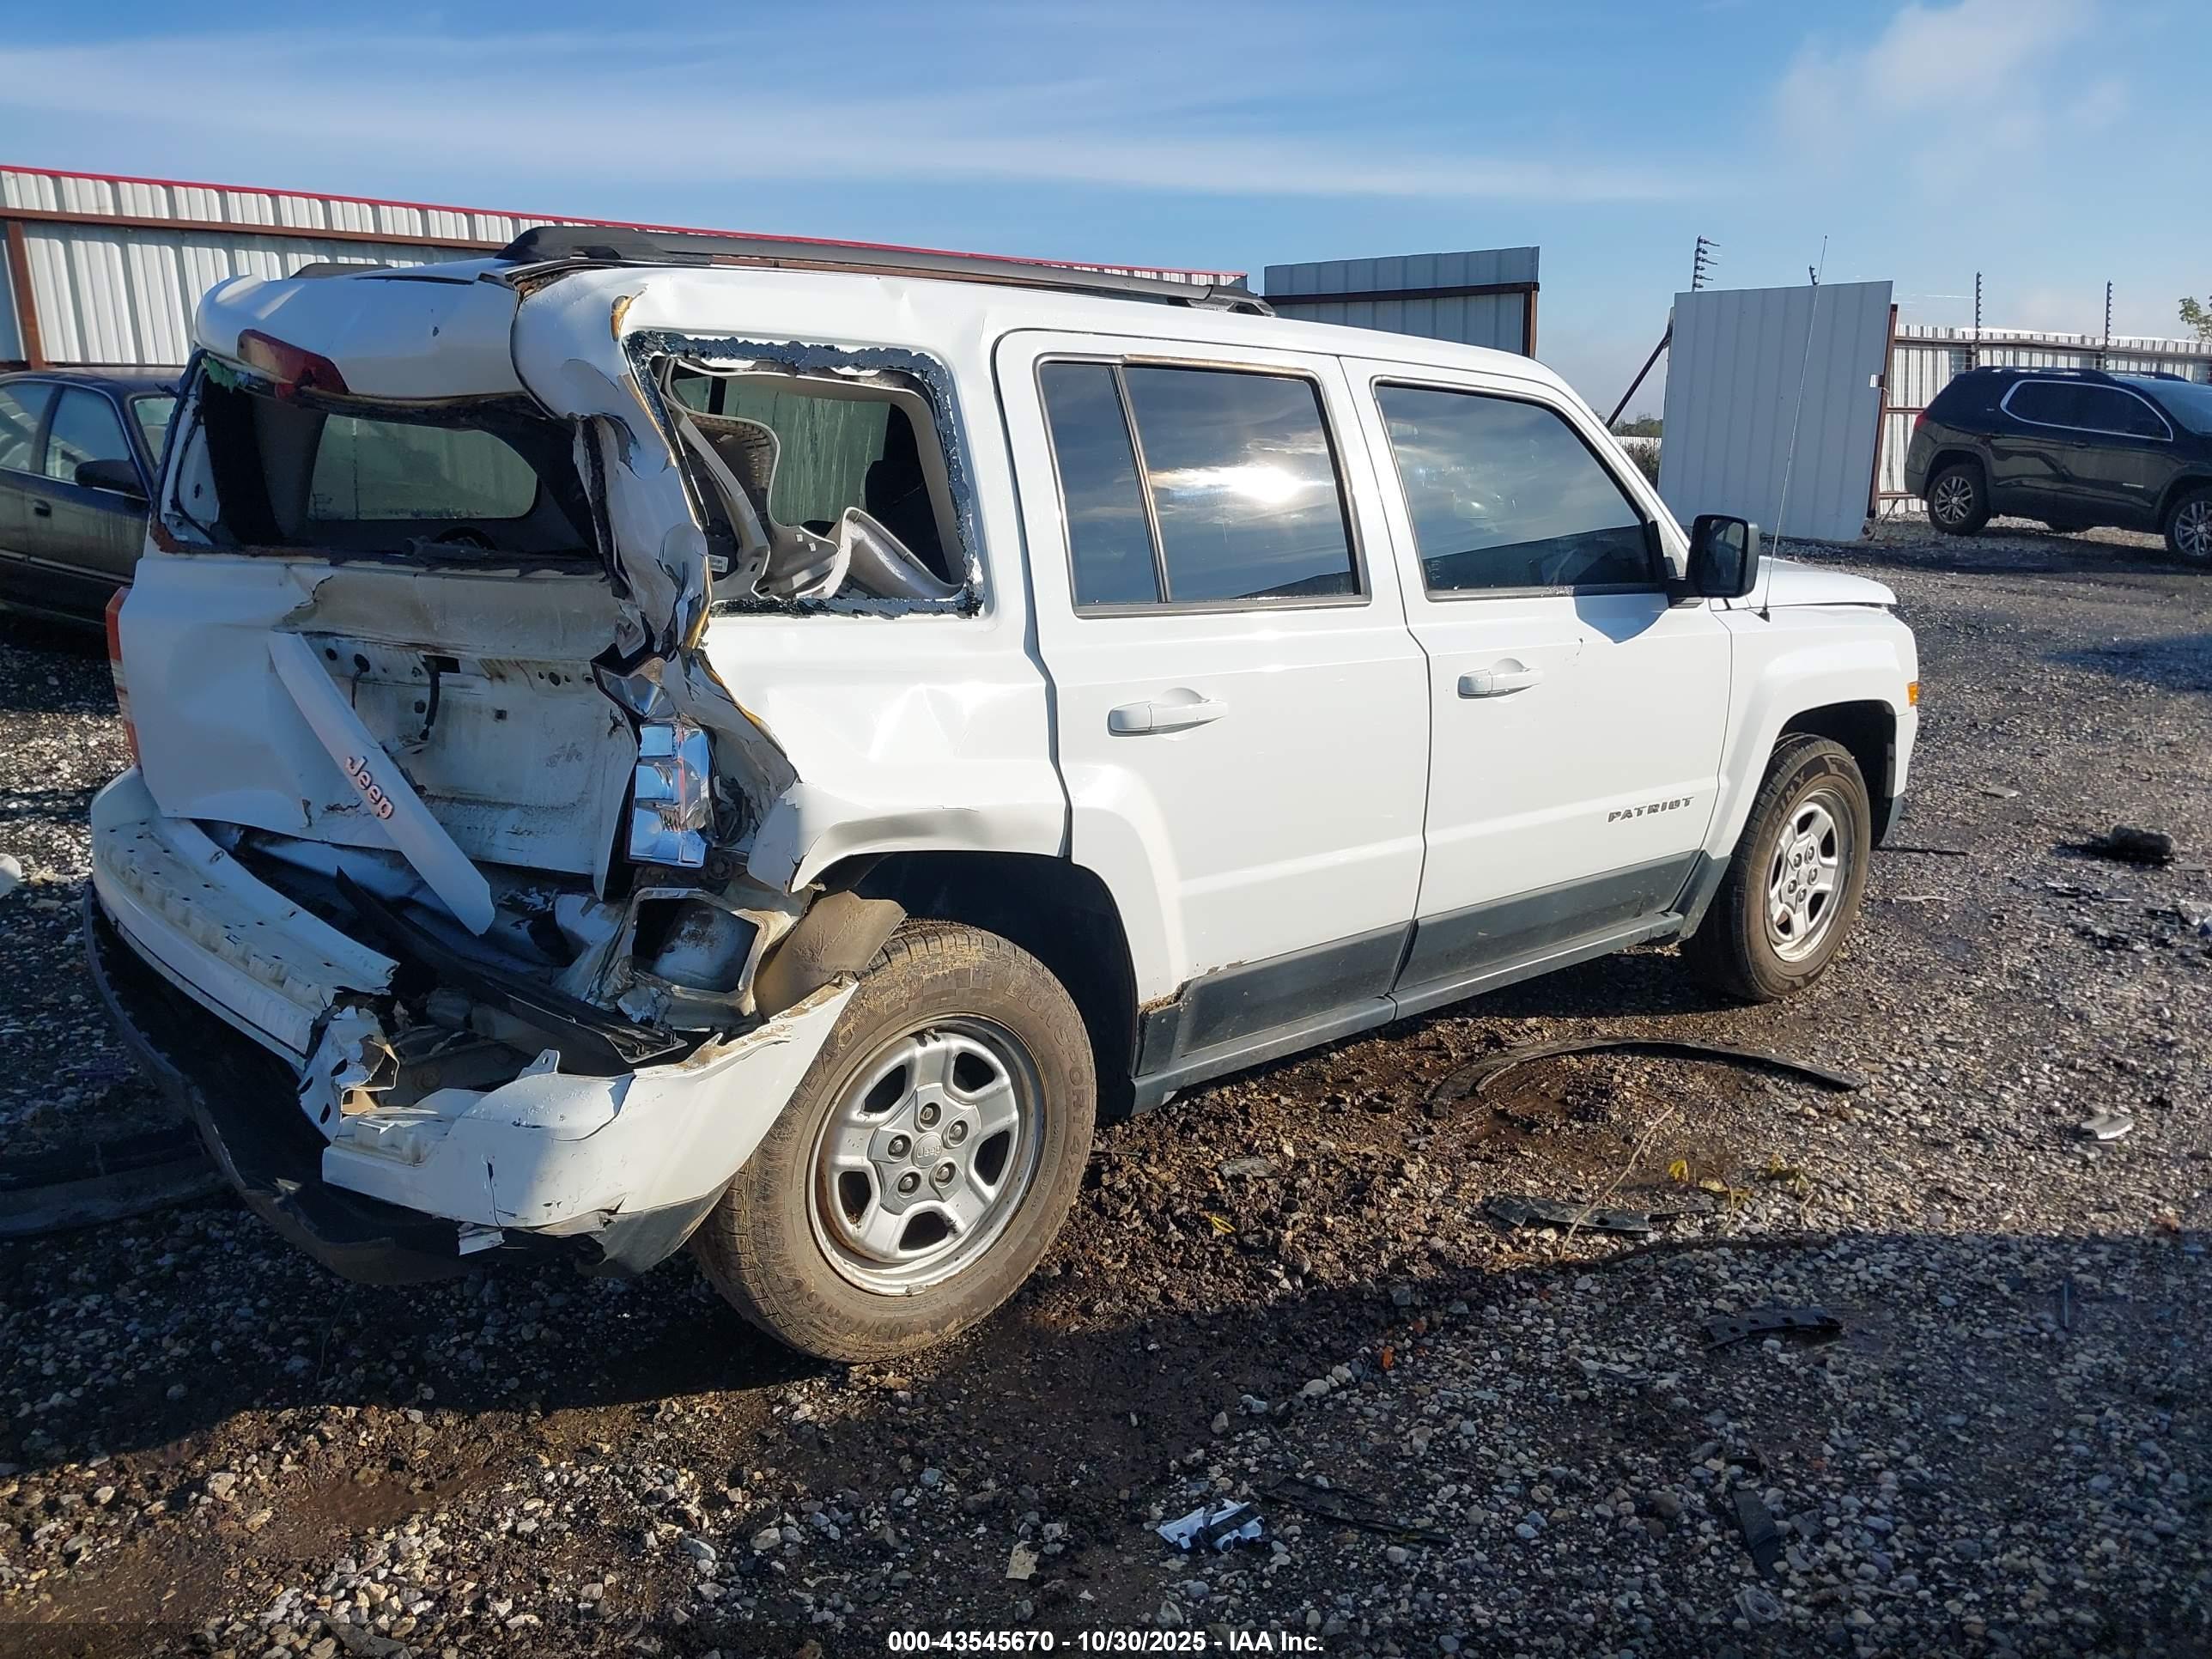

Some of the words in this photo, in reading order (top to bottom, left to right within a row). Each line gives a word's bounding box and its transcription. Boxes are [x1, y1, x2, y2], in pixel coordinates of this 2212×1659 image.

[343, 755, 394, 820] Jeep
[1607, 796, 1694, 823] PATRIOT
[1054, 1025, 1086, 1131] SPORT
[916, 1142, 941, 1158] Jeep
